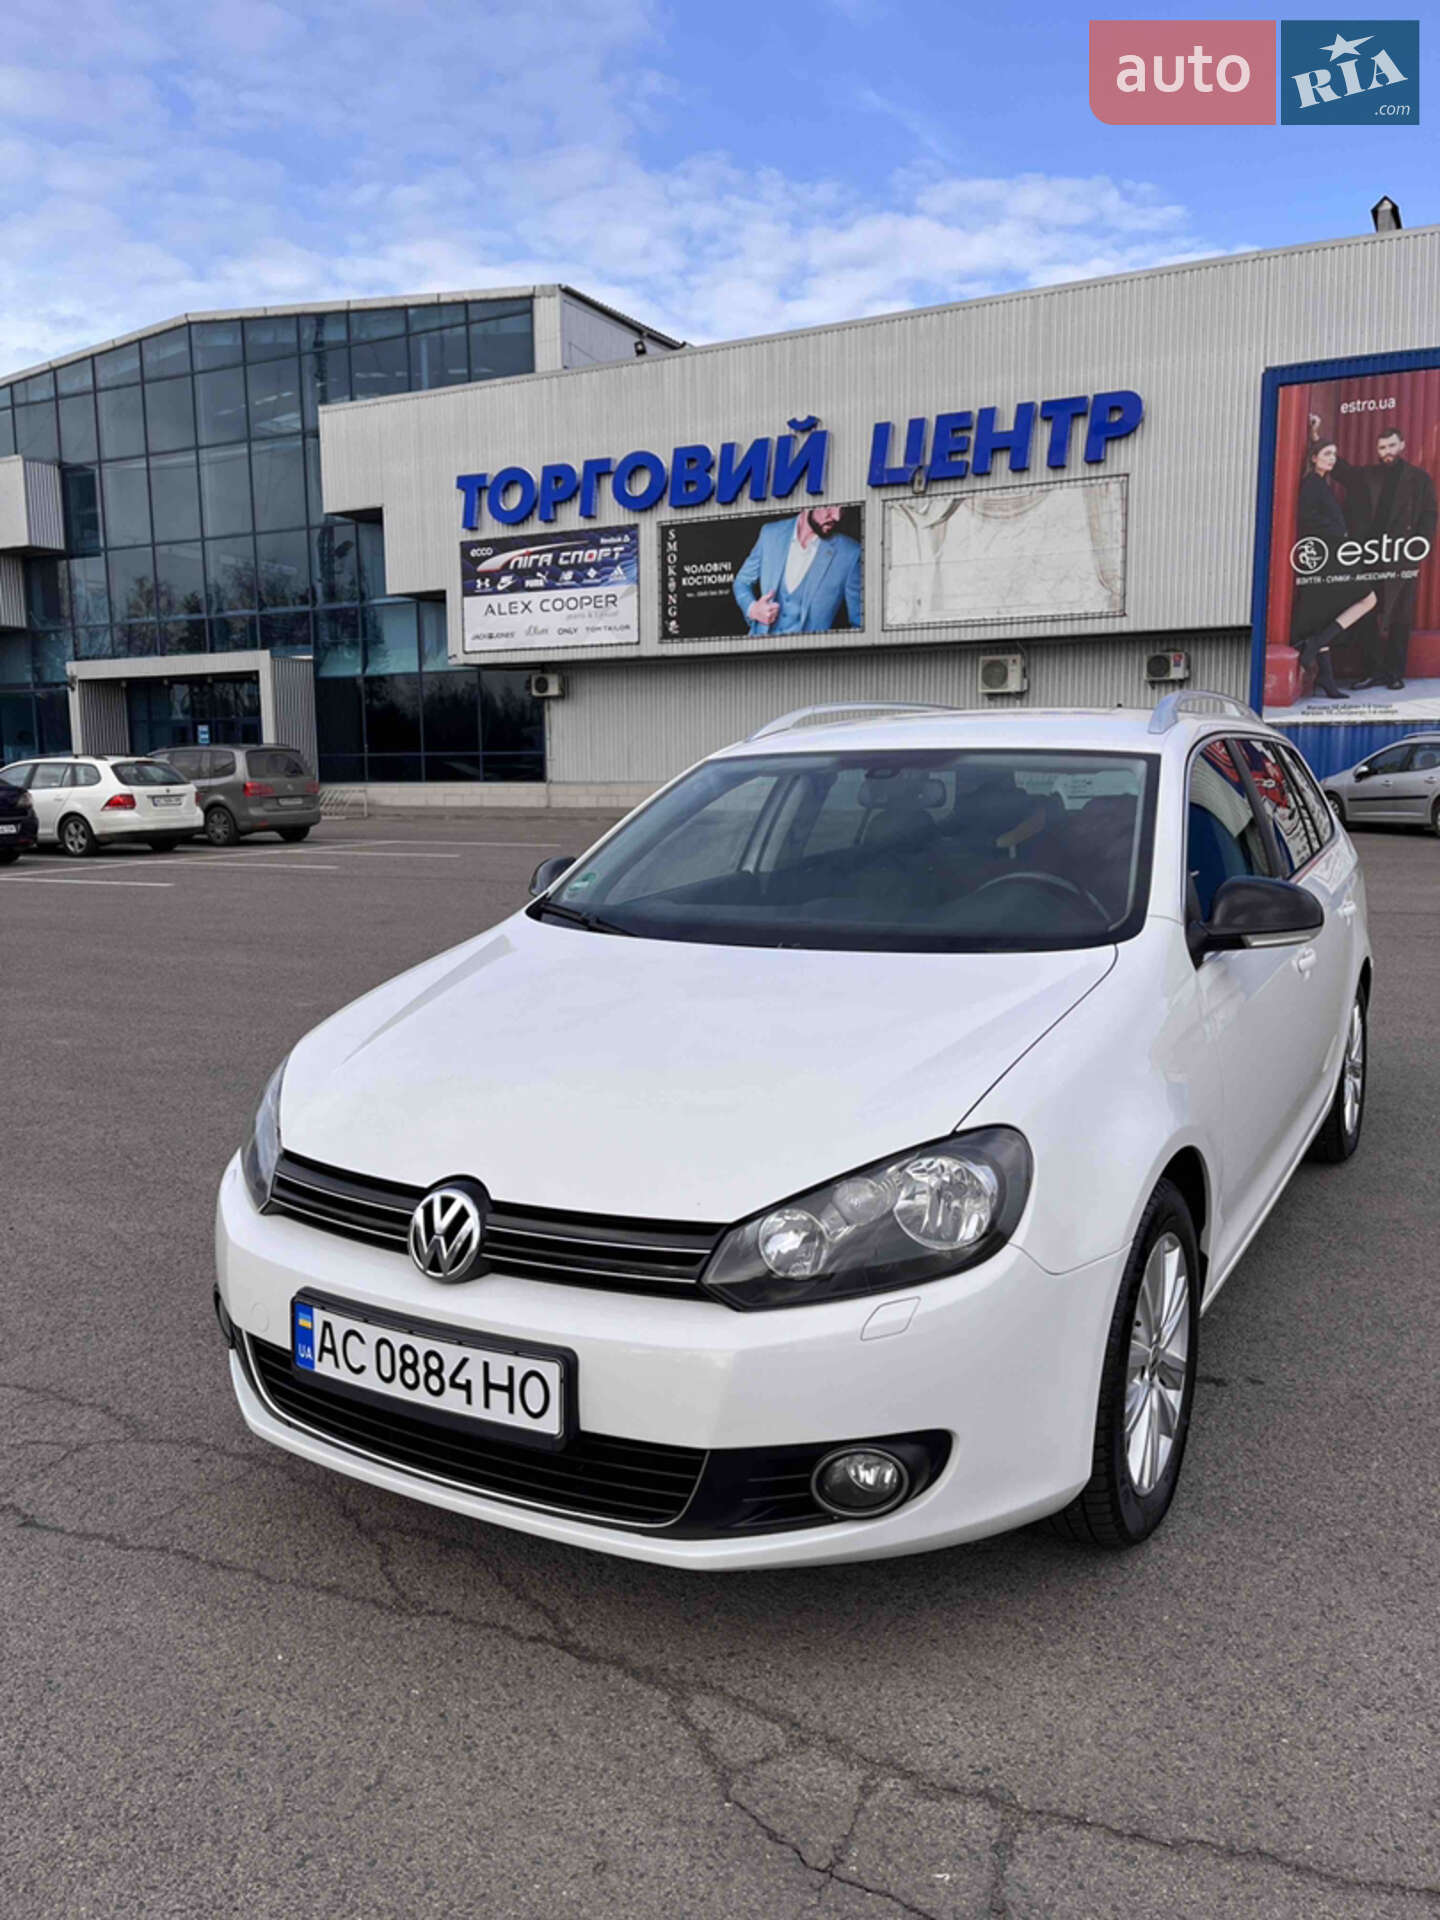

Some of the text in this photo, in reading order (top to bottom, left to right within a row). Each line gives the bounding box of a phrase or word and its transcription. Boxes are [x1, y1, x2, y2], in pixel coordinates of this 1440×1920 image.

[1340, 397, 1396, 414] estro.ua
[456, 390, 1144, 531] ТОРГОВИЙ ЦЕНТР
[470, 547, 493, 557] ecco
[558, 547, 624, 565] СПОРТ
[1337, 533, 1430, 566] estro
[681, 574, 735, 586] КОСТЮМИ
[484, 594, 618, 616] ALEX COOPER
[557, 627, 579, 636] ONLY
[298, 1343, 313, 1360] UA
[318, 1320, 550, 1419] AC 0884 HO
